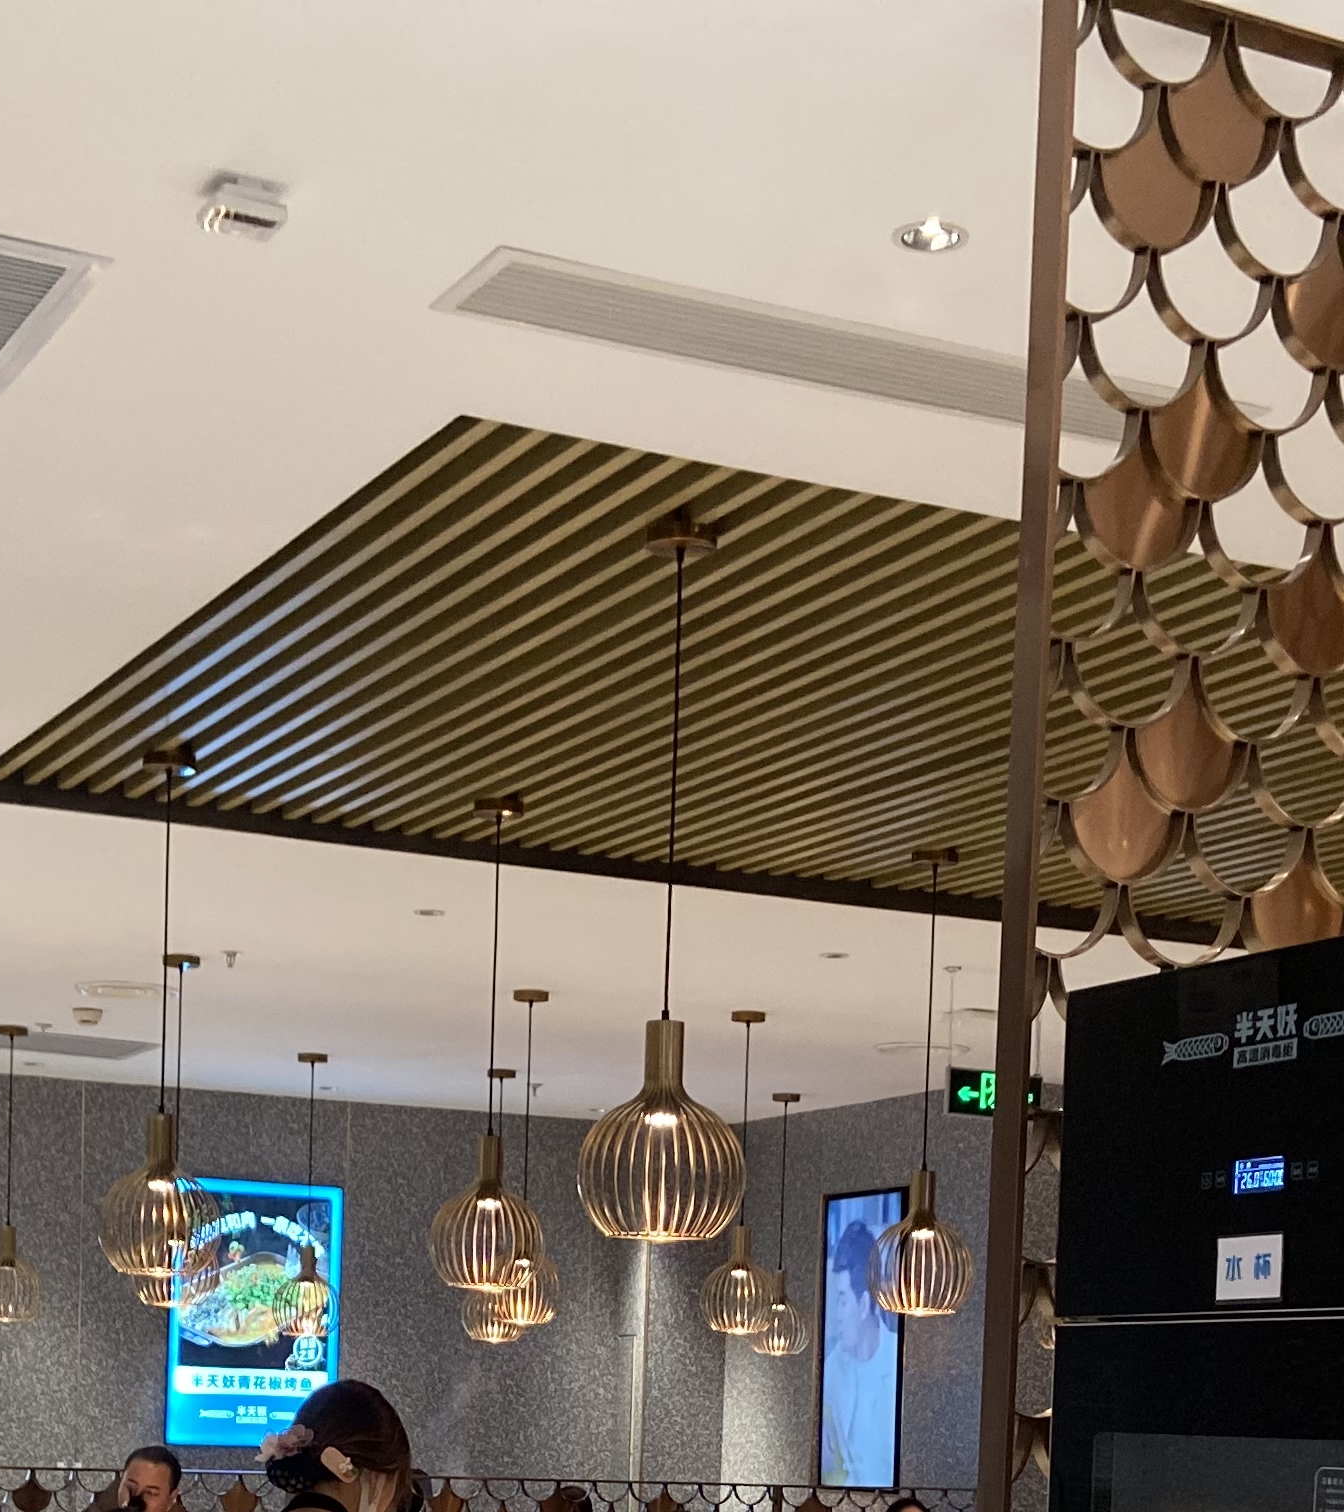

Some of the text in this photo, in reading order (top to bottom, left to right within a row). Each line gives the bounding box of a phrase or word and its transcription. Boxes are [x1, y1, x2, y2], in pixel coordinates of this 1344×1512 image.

[1234, 1002, 1297, 1044] 半天妖
[192, 1373, 312, 1391] 半天妖青花椒烤鱼
